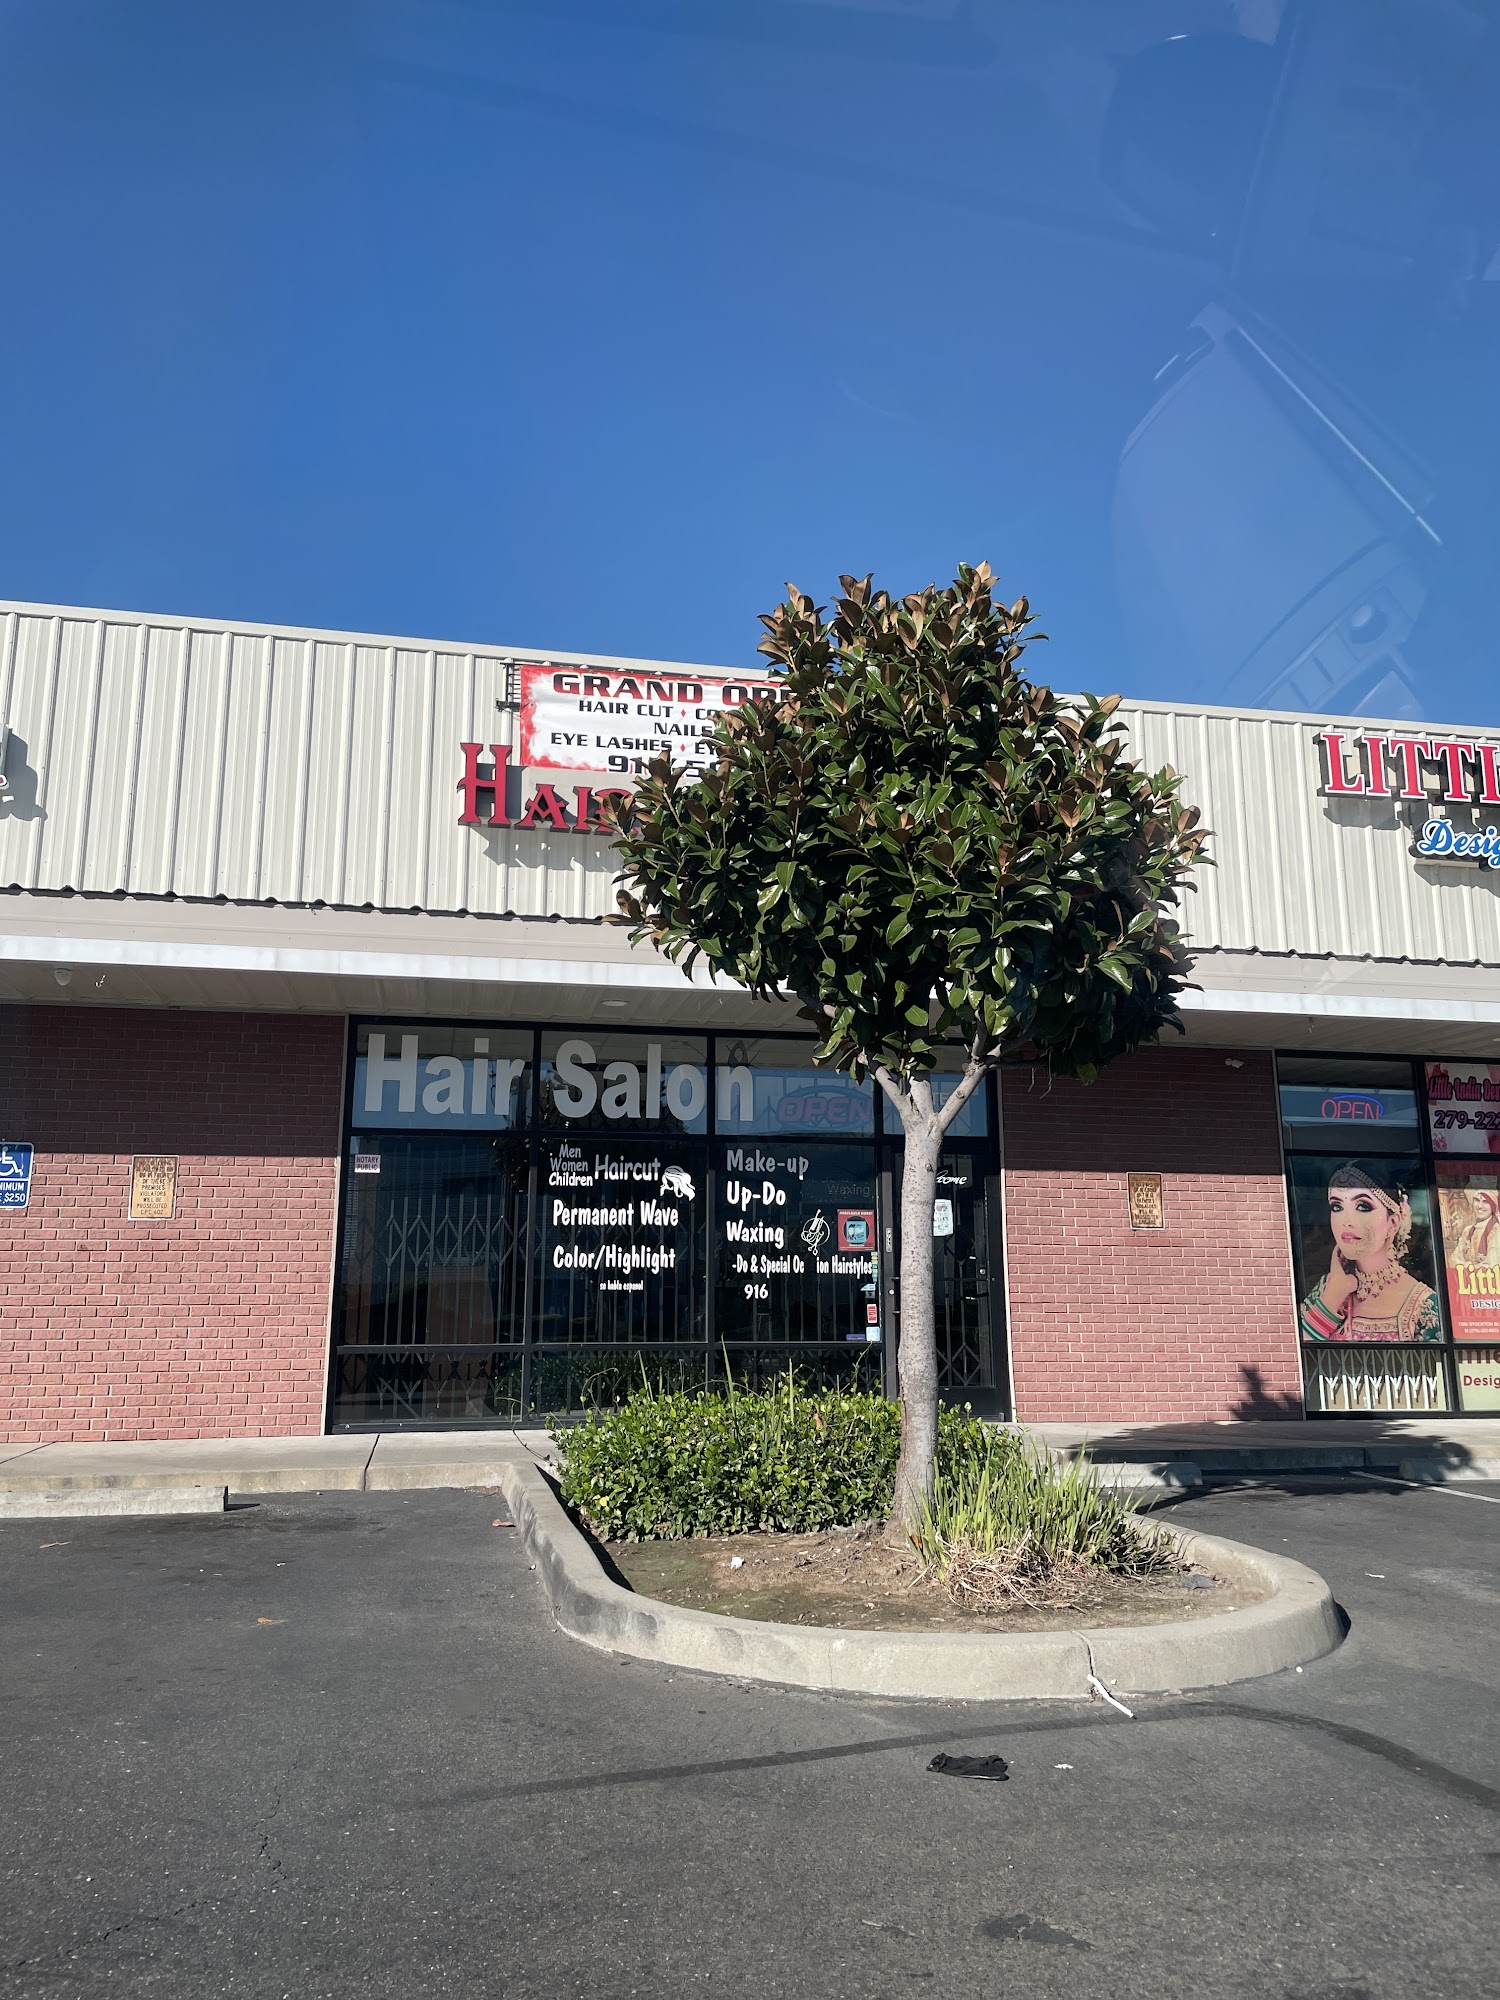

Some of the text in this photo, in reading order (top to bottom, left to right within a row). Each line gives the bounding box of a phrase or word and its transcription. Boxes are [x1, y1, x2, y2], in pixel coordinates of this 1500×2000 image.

[553, 673, 704, 704] GRAND
[579, 700, 629, 715] HAIR
[637, 704, 674, 718] CUT
[654, 722, 713, 737] NAILS
[551, 732, 588, 747] EYE
[596, 736, 673, 752] LASHES
[364, 1033, 754, 1122] Hair Salon
[1428, 1075, 1453, 1100] Little
[1454, 1076, 1482, 1101] India
[779, 1096, 873, 1124] OPEN
[1321, 1099, 1380, 1120] OPEN
[558, 1143, 582, 1158] Men
[550, 1157, 588, 1172] Women
[595, 1154, 661, 1181] Haircut
[726, 1149, 809, 1180] Make-up
[549, 1172, 593, 1187] Children
[827, 1183, 870, 1197] Waxing
[4, 1192, 25, 1203] $250
[726, 1180, 786, 1211] Up-Do
[553, 1199, 679, 1226] Permanent Wave
[726, 1219, 784, 1249] Waxing
[553, 1244, 676, 1274] Color/Highlight
[750, 1255, 758, 1273] &
[760, 1255, 791, 1278] Special
[832, 1255, 872, 1279] Hairstyles
[744, 1284, 768, 1299] 916
